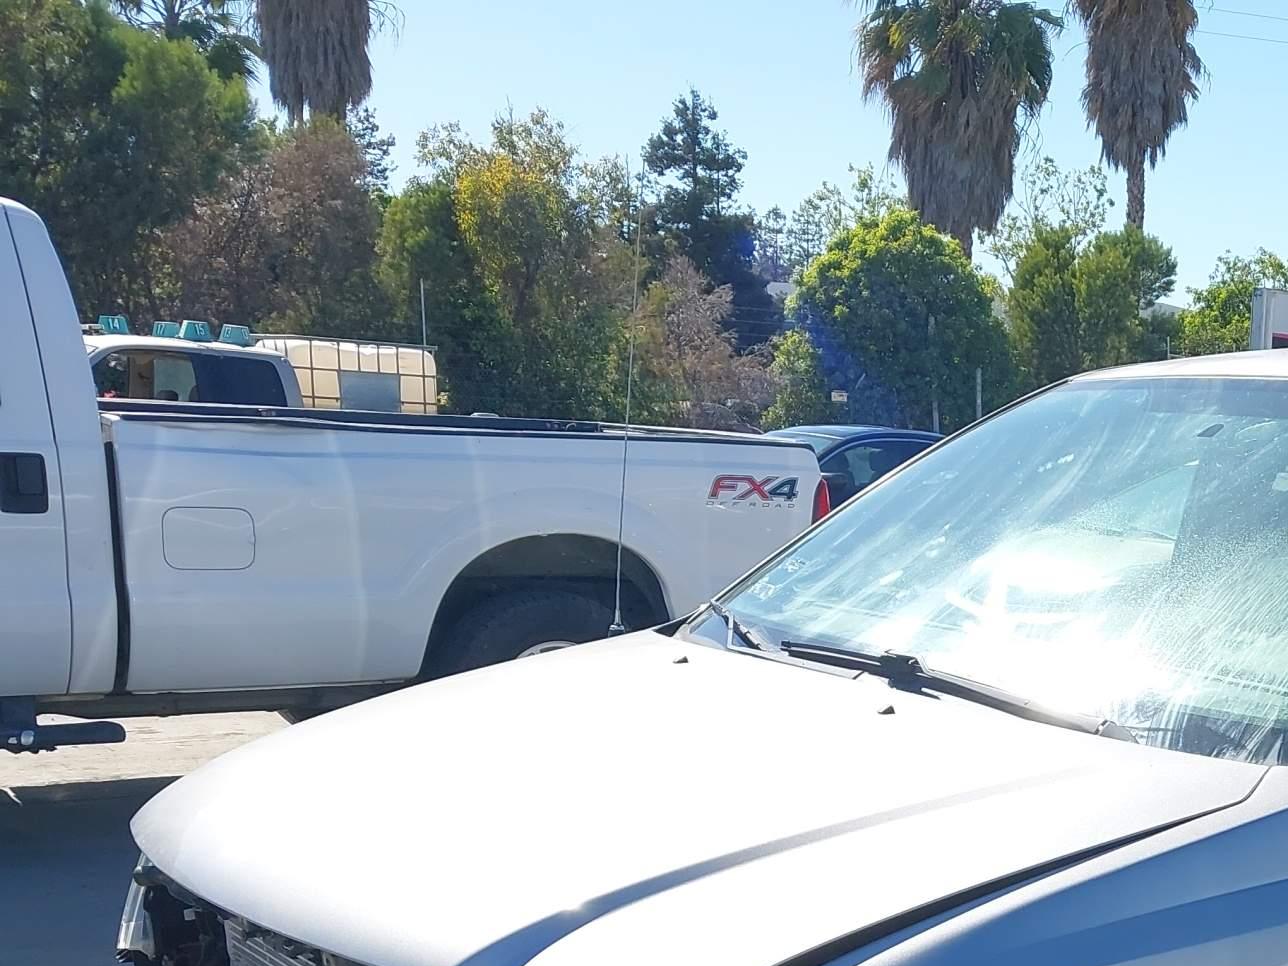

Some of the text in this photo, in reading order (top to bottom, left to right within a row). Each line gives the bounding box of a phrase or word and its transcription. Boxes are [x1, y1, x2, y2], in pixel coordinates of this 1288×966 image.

[108, 318, 120, 331] 14
[194, 323, 205, 336] 15
[707, 474, 800, 502] FX4
